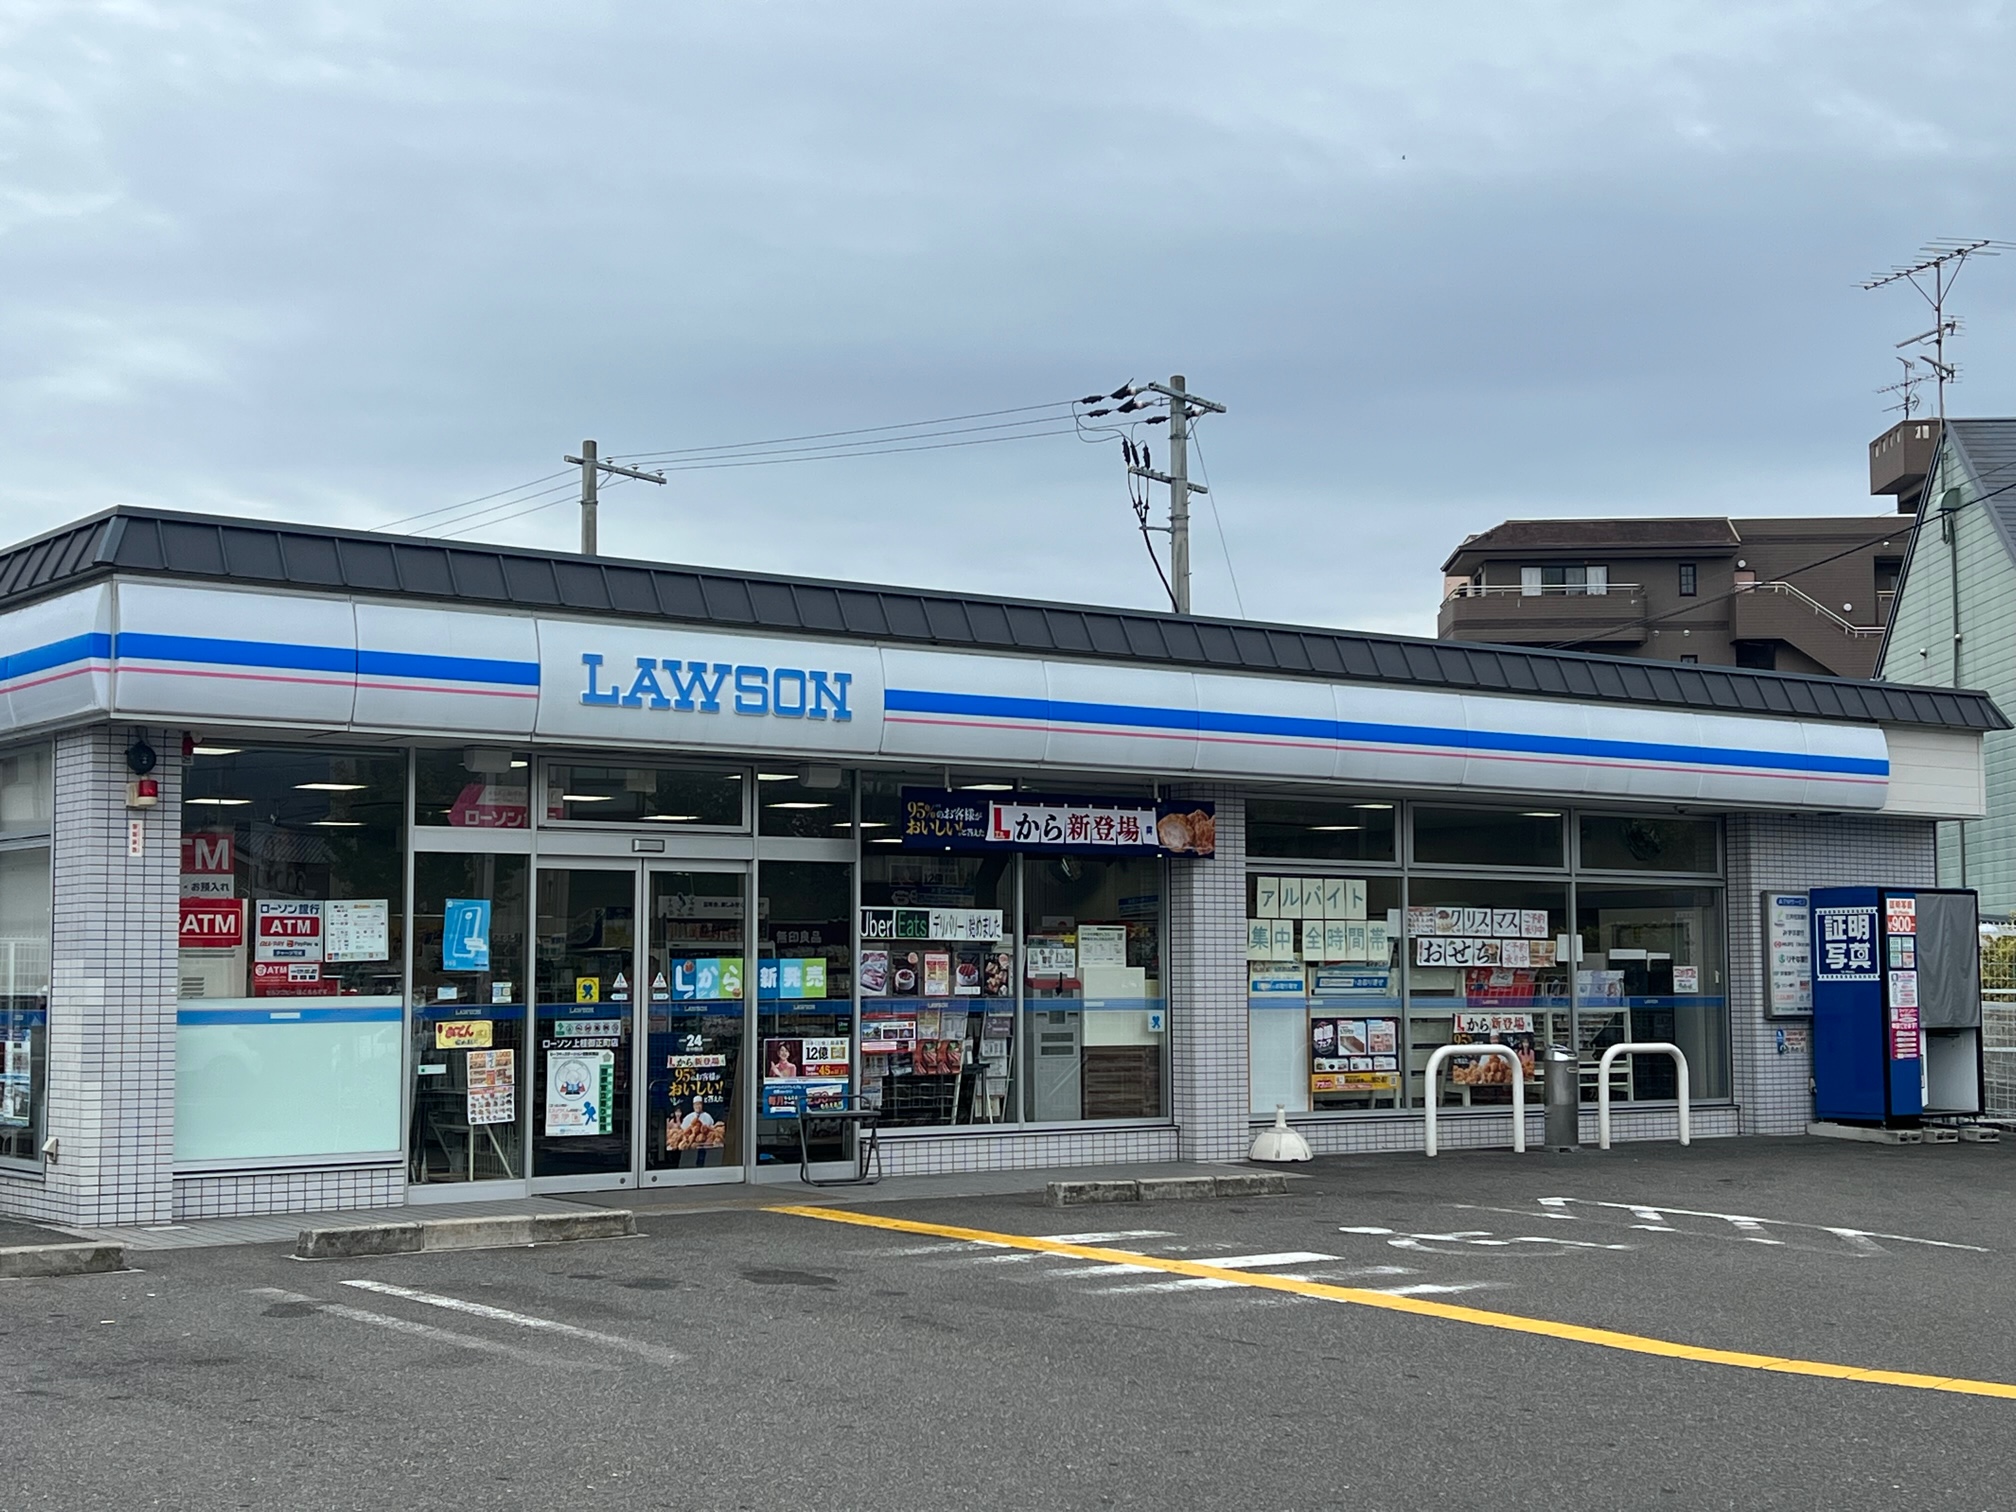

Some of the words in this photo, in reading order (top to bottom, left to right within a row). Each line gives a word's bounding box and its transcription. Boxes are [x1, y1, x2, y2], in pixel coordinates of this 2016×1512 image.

[579, 653, 852, 722] LAWSON
[1261, 886, 1363, 909] アルバイト
[261, 904, 319, 914] ローソン銀行
[1451, 910, 1518, 929] クリスマス
[181, 913, 235, 934] ATM
[270, 920, 311, 934] ATM
[860, 911, 893, 937] Uber
[898, 912, 927, 937] Eats
[933, 914, 964, 938] デリバリー
[969, 914, 1001, 938] 始めました
[1825, 914, 1870, 941] 証明
[776, 930, 822, 944] 無印良品
[1251, 926, 1291, 950] 集中
[1305, 926, 1386, 950] 全時間帯
[1423, 940, 1490, 964] おせち
[1826, 941, 1871, 969] 写真
[267, 966, 287, 974] ATM
[760, 966, 824, 988] 新発売
[687, 1034, 702, 1046] 24
[669, 1081, 724, 1096] おいしい!
